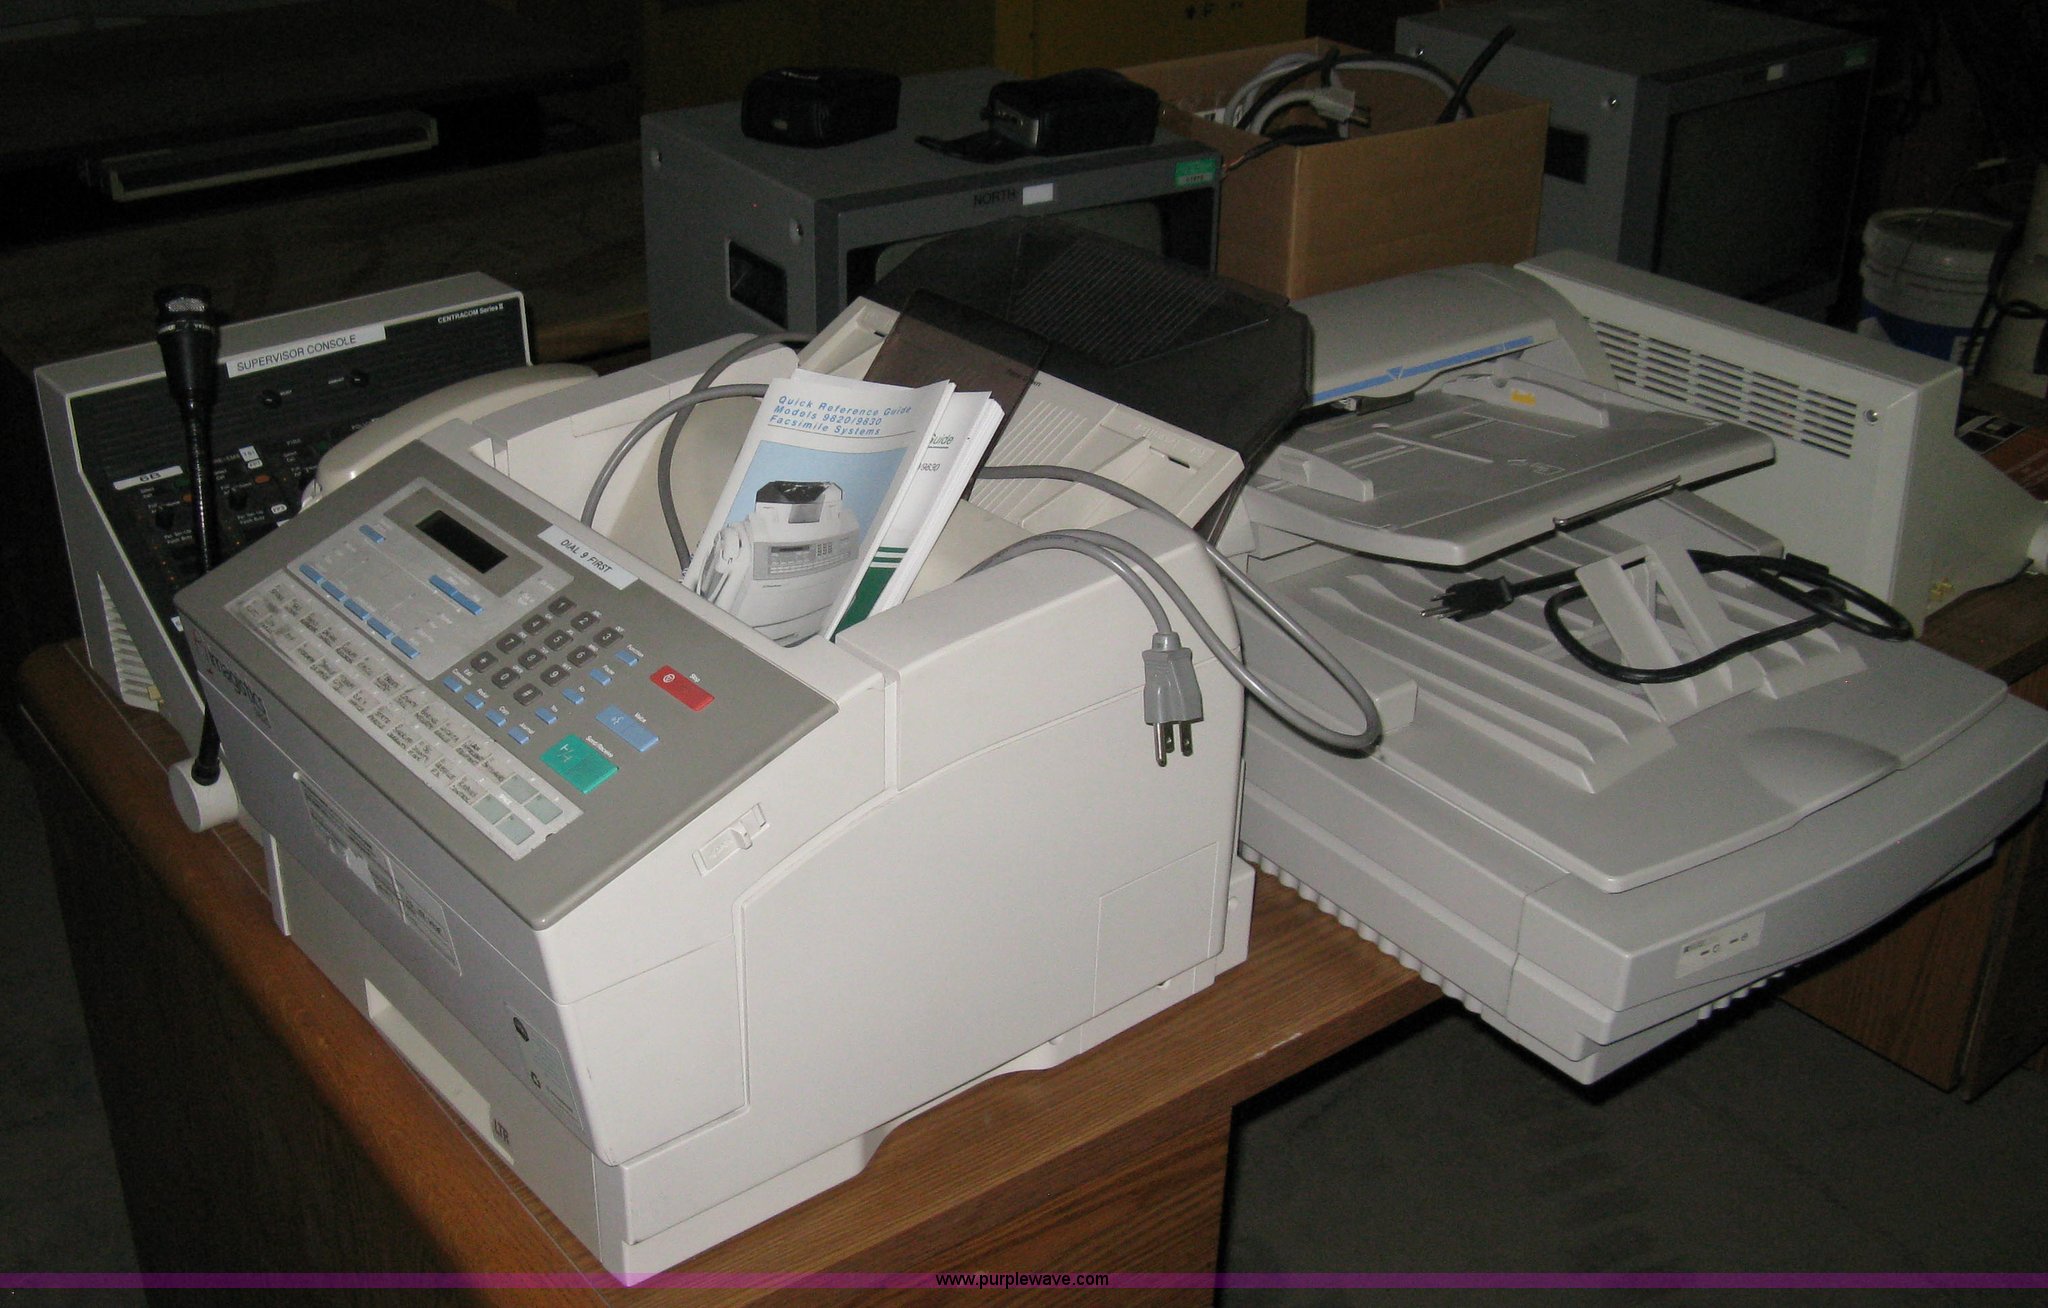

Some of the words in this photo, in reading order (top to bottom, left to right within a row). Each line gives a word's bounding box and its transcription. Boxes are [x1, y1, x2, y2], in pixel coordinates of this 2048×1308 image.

[973, 189, 1017, 206] NORTH
[437, 308, 479, 324] CENTRACOM
[479, 304, 499, 314] Series
[236, 347, 305, 372] SUPERVISOR
[306, 334, 357, 355] CONSOLE
[774, 405, 817, 420] Models
[822, 413, 882, 426] 9820/9830
[778, 396, 813, 408] Quick
[818, 402, 879, 416] Reference
[883, 406, 912, 416] Guide
[769, 415, 829, 432] Facsimile
[834, 425, 881, 436] Systems
[560, 539, 580, 554] DIAL
[587, 556, 613, 573] FIRST
[579, 617, 588, 625] 2
[553, 635, 562, 643] 5
[603, 633, 611, 641] 3
[576, 651, 585, 659] 6
[550, 670, 559, 678] 9
[494, 1118, 509, 1145] LTR
